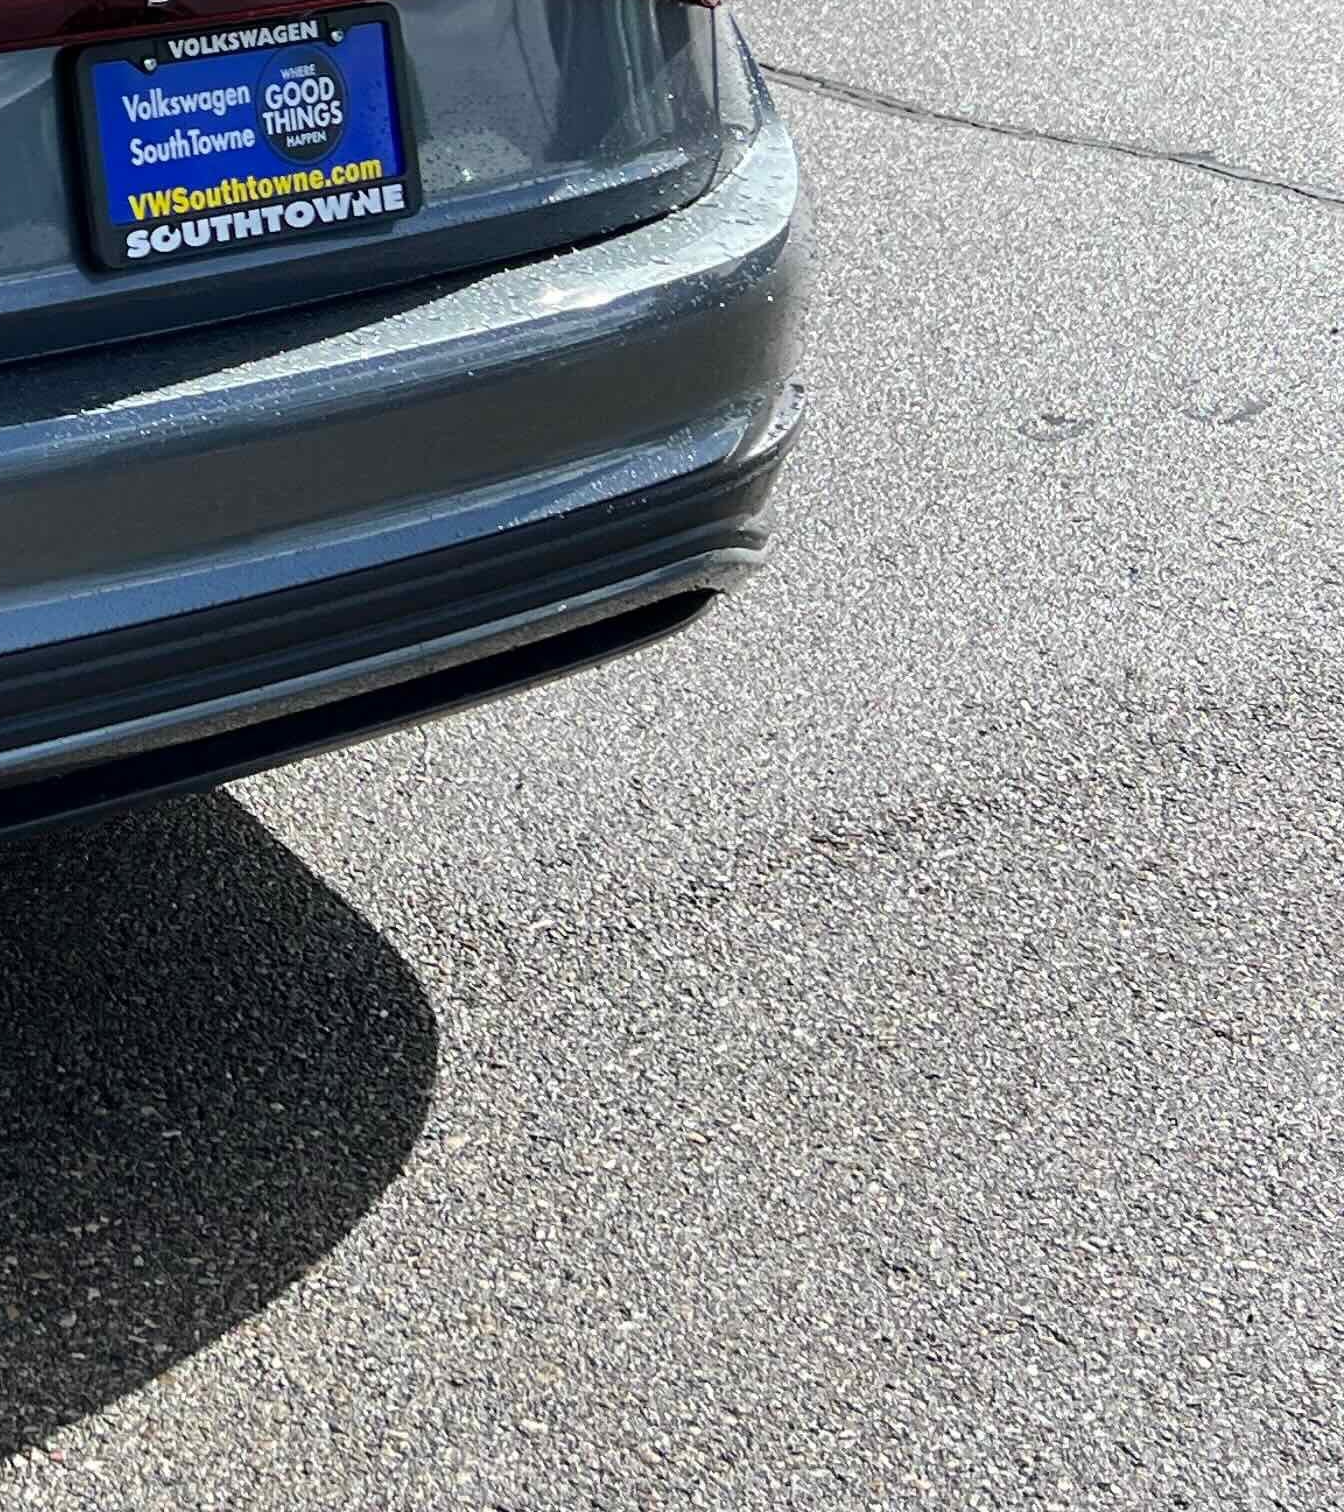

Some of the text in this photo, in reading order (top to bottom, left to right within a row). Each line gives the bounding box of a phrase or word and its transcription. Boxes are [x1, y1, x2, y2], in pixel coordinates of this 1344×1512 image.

[167, 19, 320, 59] VOLKSWAGEN
[121, 84, 251, 123] Volkswagen
[264, 76, 335, 110] GOOD
[262, 100, 344, 136] THINGS
[129, 128, 256, 167] SouthTowne
[285, 130, 328, 148] HAPPEN
[127, 158, 382, 222] VWSouthtowne.com
[125, 183, 406, 259] SOUTHTOWNE
